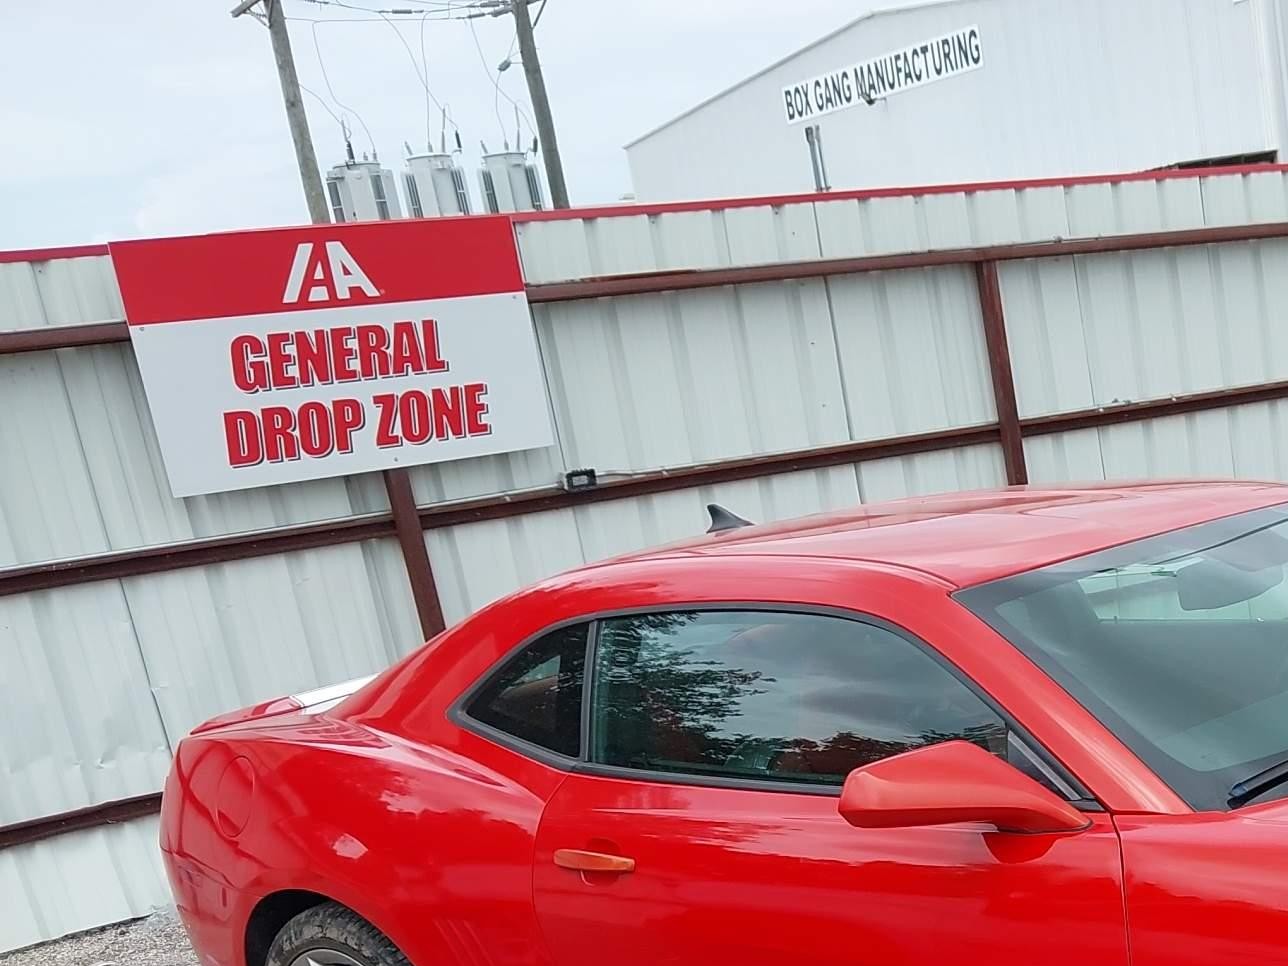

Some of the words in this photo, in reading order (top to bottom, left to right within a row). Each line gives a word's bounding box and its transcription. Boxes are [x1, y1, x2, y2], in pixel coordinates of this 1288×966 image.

[784, 82, 813, 120] BOX
[814, 71, 852, 111] GANG
[854, 29, 981, 98] MANUFACTURING
[230, 319, 449, 394] GENERAL
[223, 398, 365, 468] DROP
[372, 382, 492, 448] ZONE
